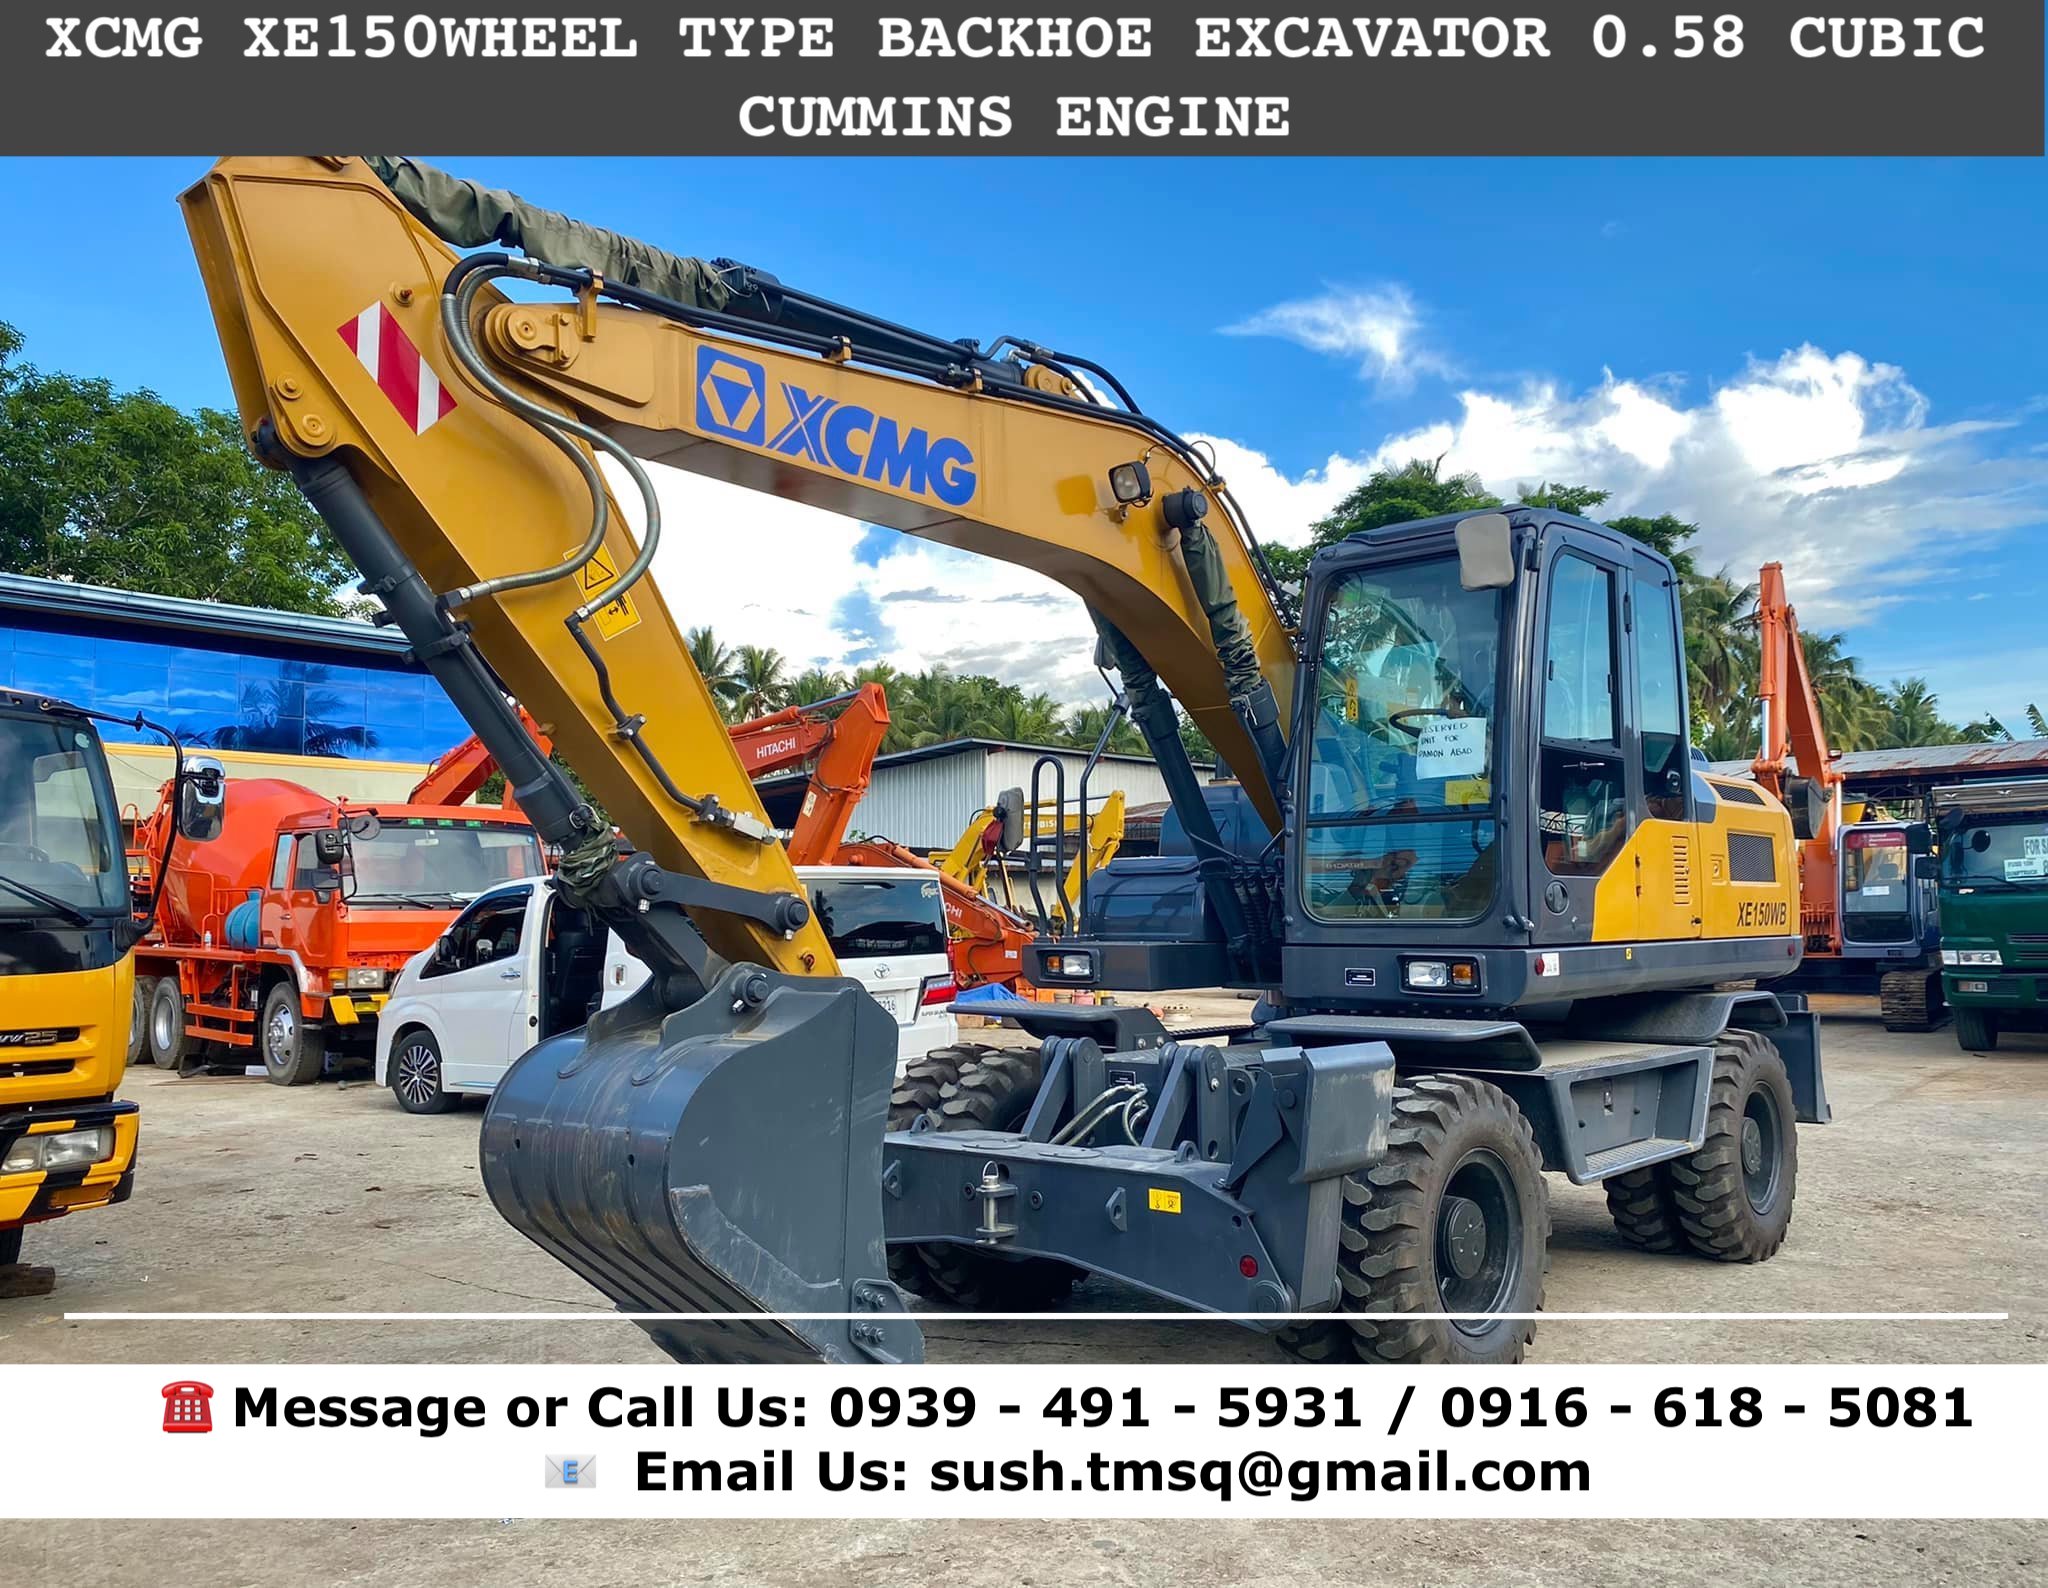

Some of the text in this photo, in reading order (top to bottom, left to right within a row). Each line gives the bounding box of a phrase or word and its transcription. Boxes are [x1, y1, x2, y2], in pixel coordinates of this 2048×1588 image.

[766, 382, 976, 506] XCMG
[756, 737, 796, 759] HITACHI
[2025, 839, 2041, 856] FOR
[1737, 902, 1787, 927] XE150WB
[25, 1030, 58, 1044] 25
